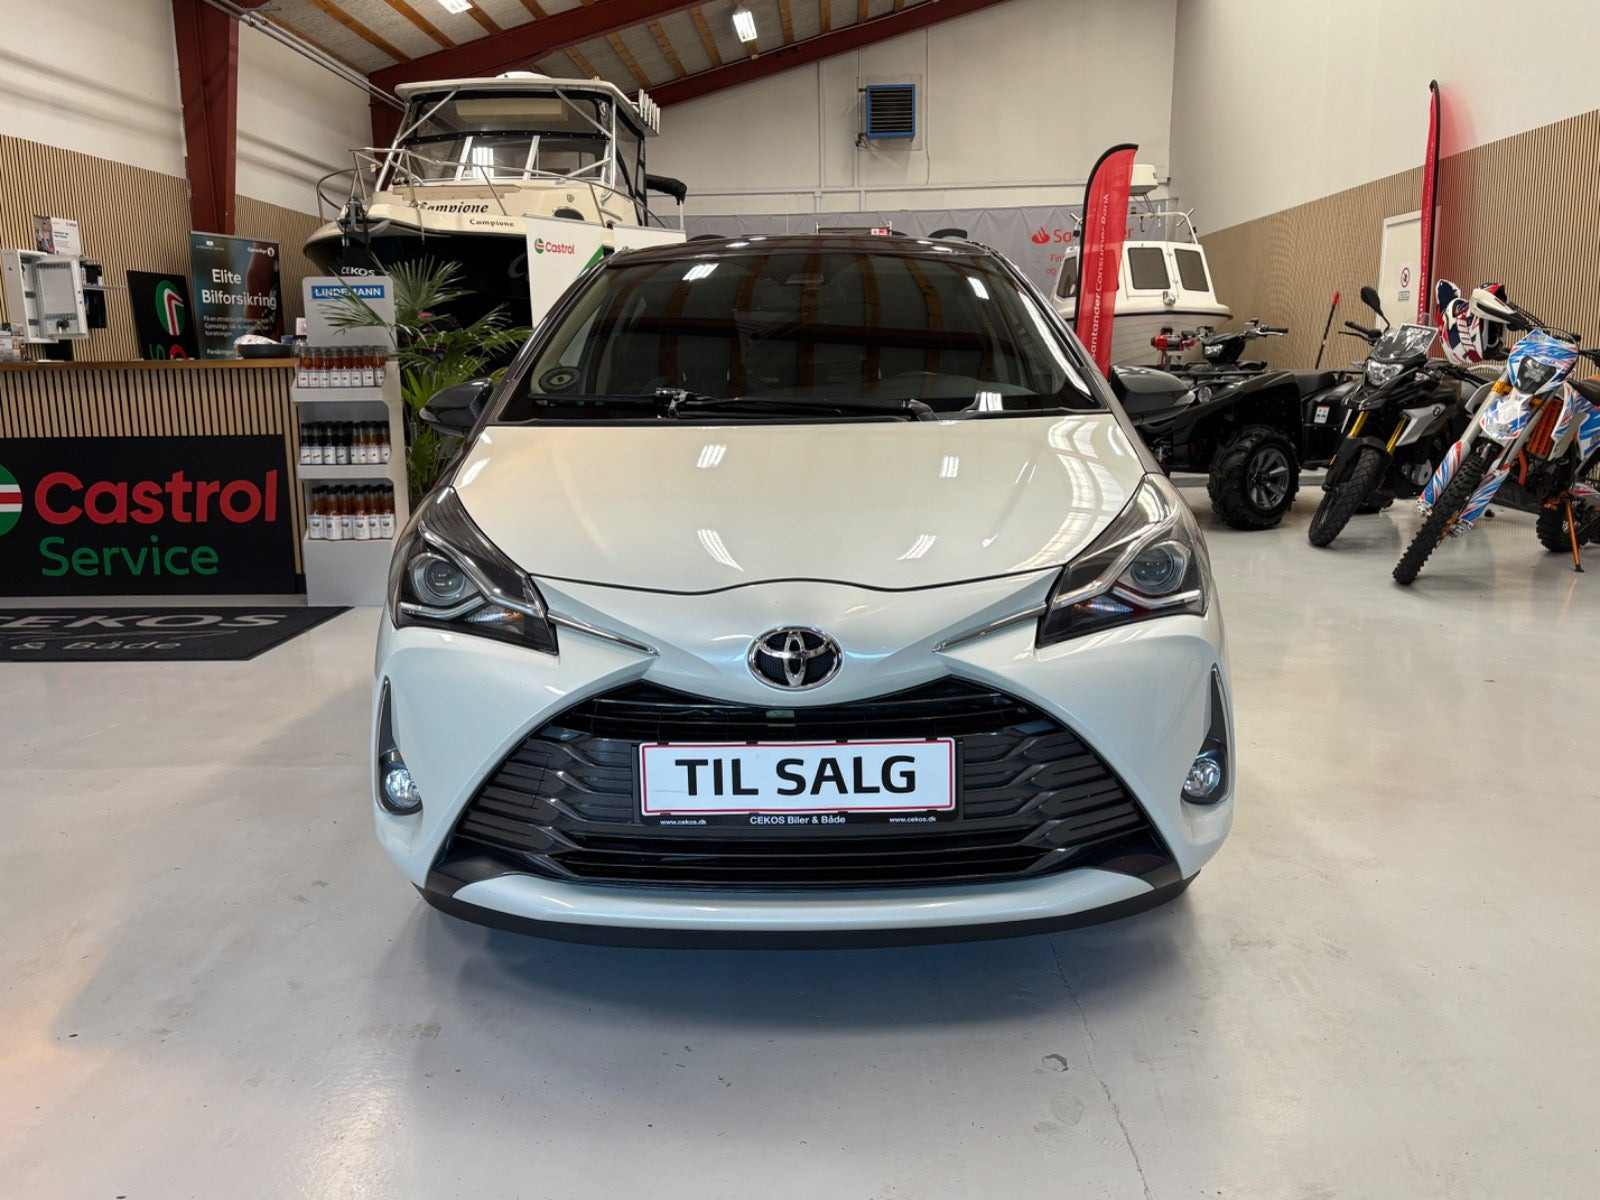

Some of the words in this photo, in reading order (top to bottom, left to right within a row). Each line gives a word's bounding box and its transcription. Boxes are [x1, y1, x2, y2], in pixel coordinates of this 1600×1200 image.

[1100, 192, 1110, 225] Bank
[469, 218, 514, 227] Campione
[545, 241, 575, 255] Castrol
[1096, 227, 1106, 292] Consumer
[212, 268, 242, 285] Elite
[201, 289, 277, 310] Bilforsikring
[34, 469, 278, 525] Castrol
[39, 535, 219, 577] Service
[675, 758, 759, 796] TIL
[776, 755, 916, 796] SALG
[660, 818, 707, 826] www.cekos.dk
[750, 815, 785, 825] CEKOS
[787, 815, 809, 825] Biler
[811, 815, 819, 824] &
[821, 814, 846, 824] Både
[889, 815, 937, 823] www.cekos.dk
